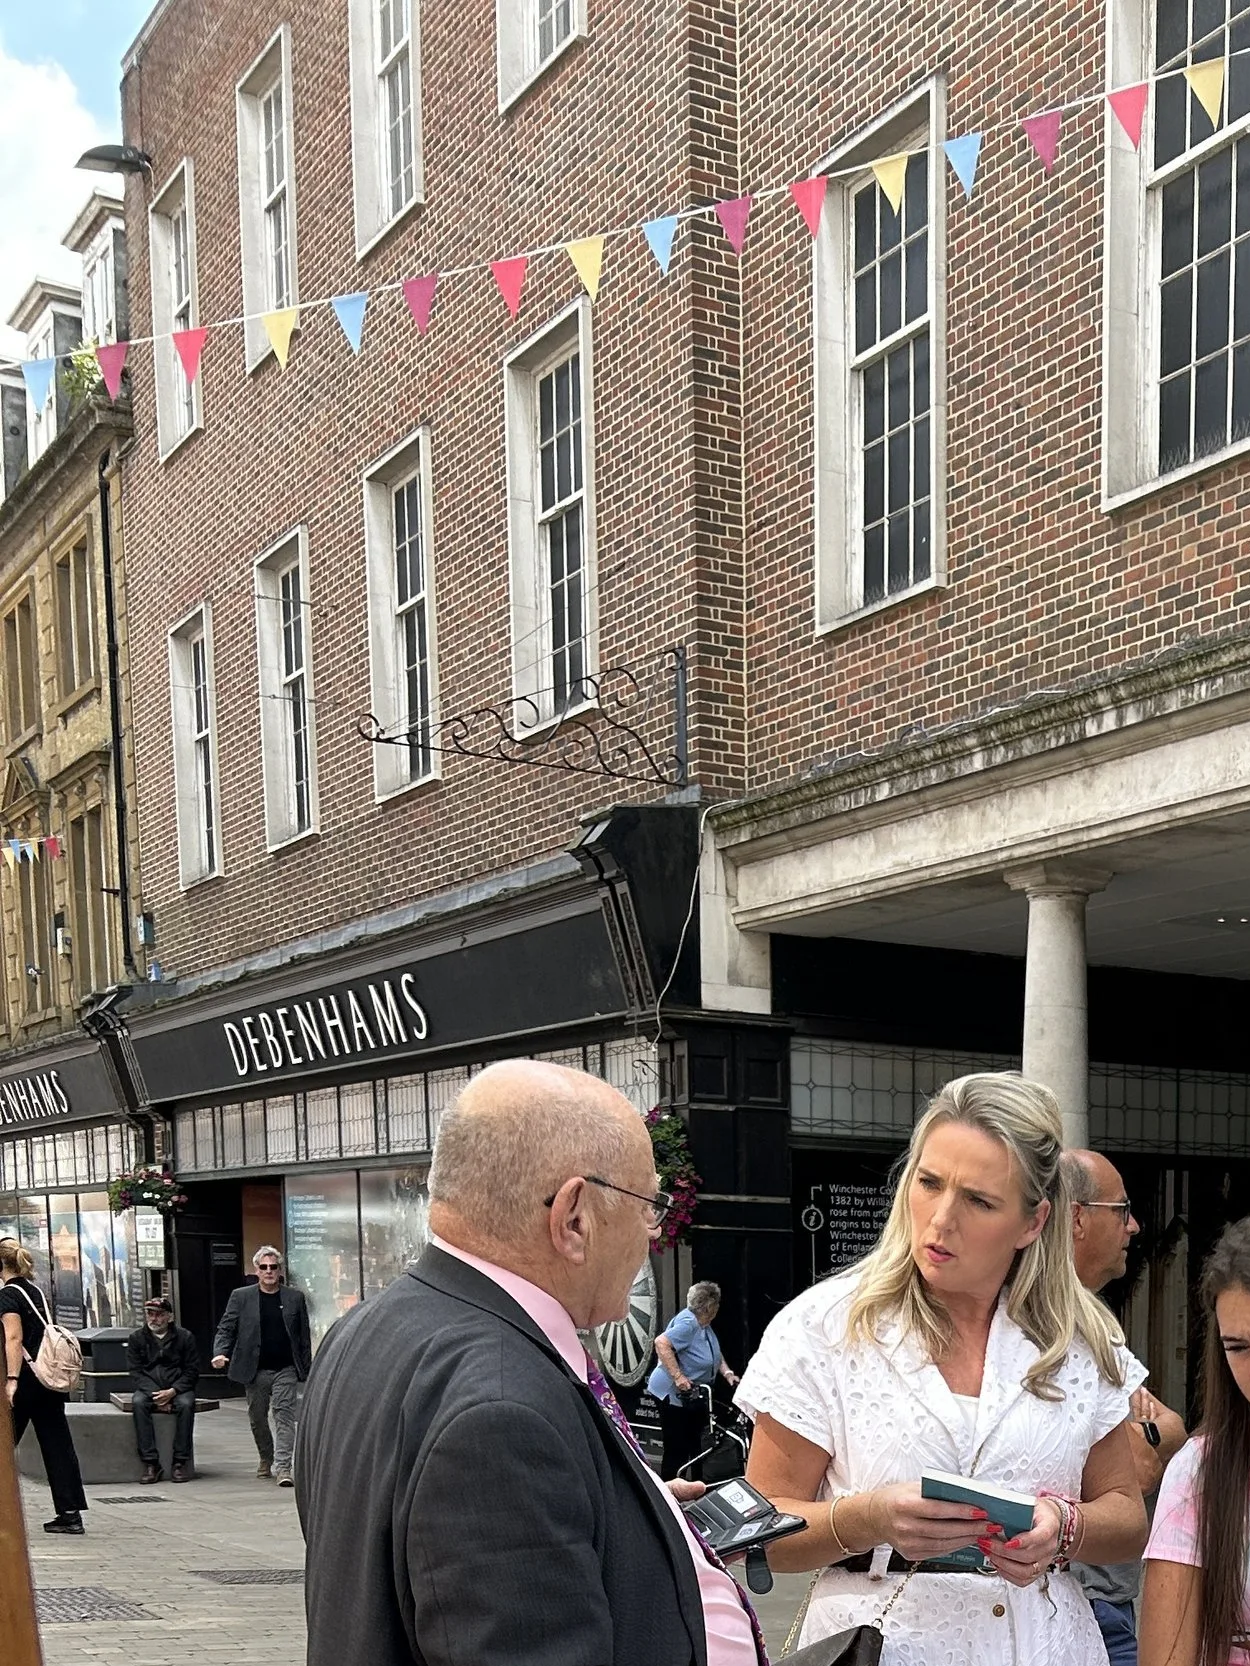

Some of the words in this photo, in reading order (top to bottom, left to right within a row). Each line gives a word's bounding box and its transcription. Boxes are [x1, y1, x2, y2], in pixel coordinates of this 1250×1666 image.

[224, 972, 428, 1077] DEBENHAMS
[0, 1070, 69, 1126] ENHAMS
[829, 1184, 877, 1195] Winchester
[831, 1196, 851, 1205] 1382
[854, 1196, 864, 1207] by
[829, 1209, 848, 1217] rose
[851, 1208, 870, 1218] from
[829, 1220, 859, 1230] origins
[861, 1220, 870, 1229] to
[830, 1242, 839, 1251] of
